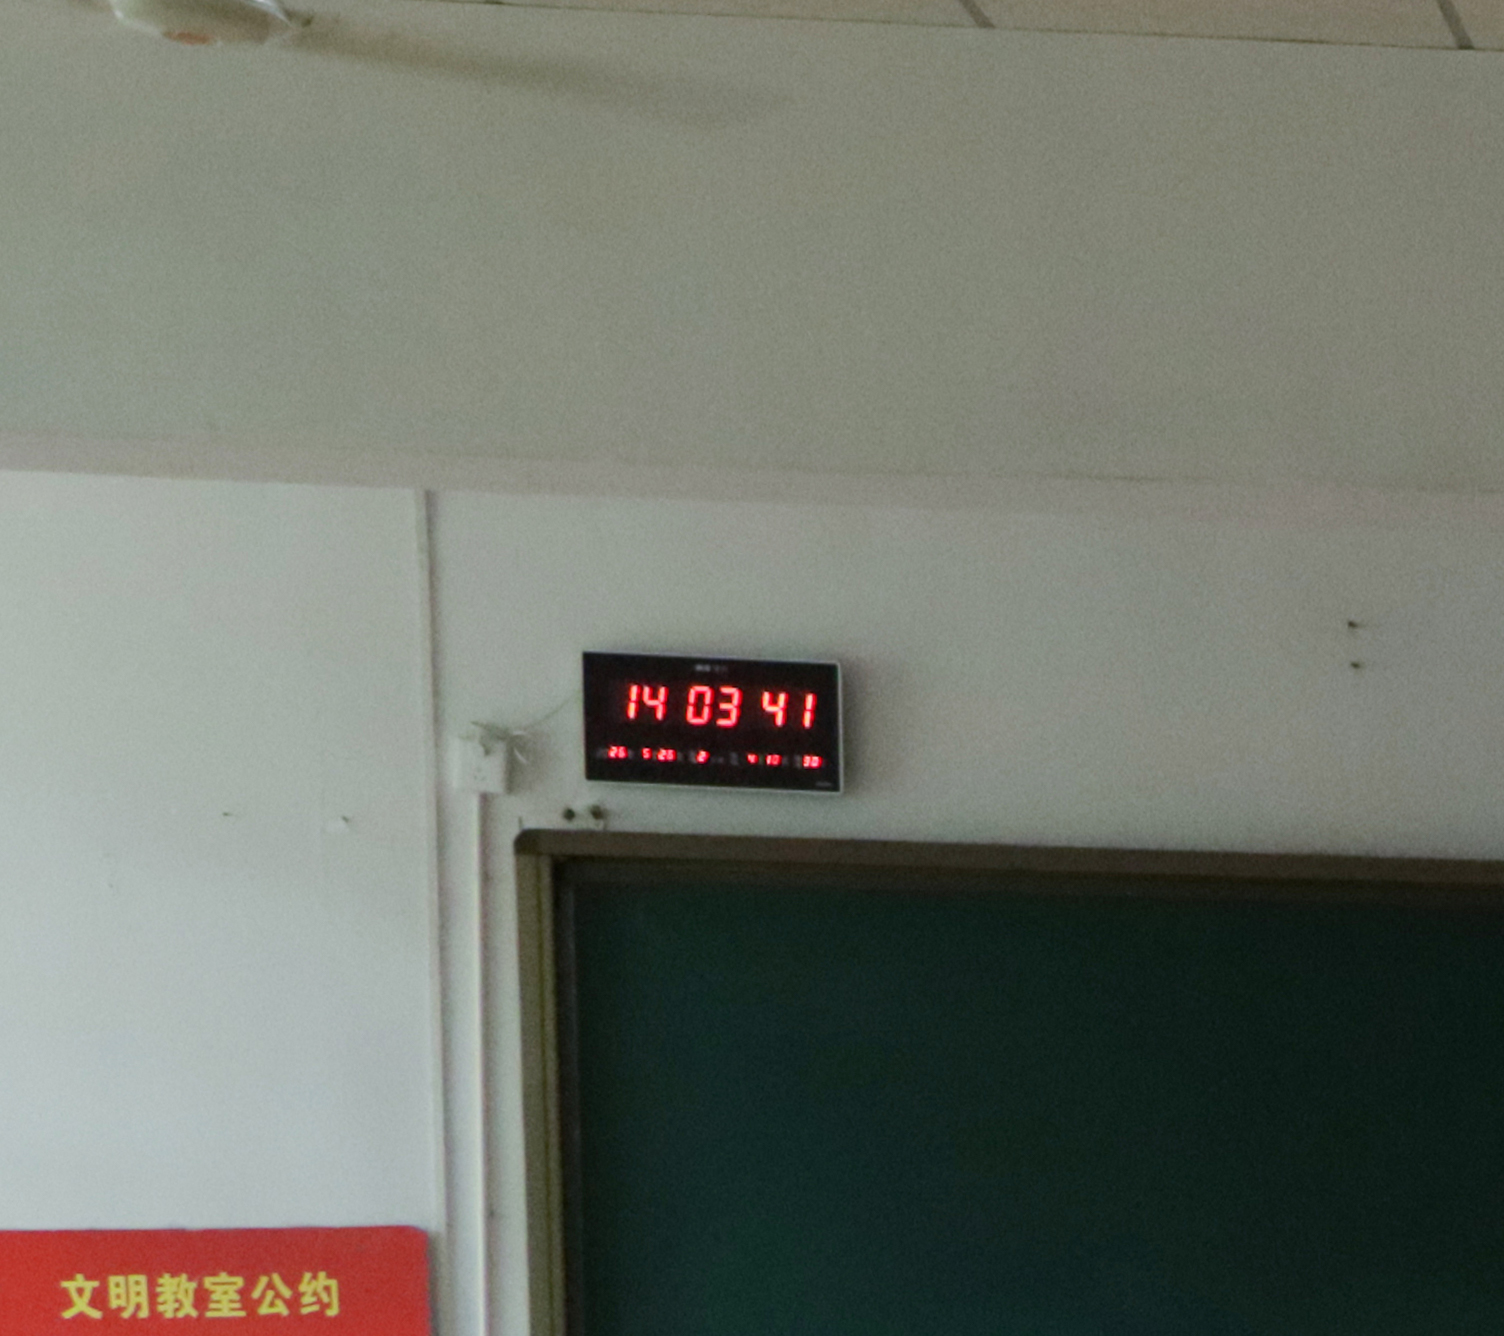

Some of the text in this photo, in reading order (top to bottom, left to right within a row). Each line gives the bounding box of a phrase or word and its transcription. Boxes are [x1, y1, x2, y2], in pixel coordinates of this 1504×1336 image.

[627, 684, 816, 729] 14 03 41
[60, 1271, 341, 1320] 文明教室公约
